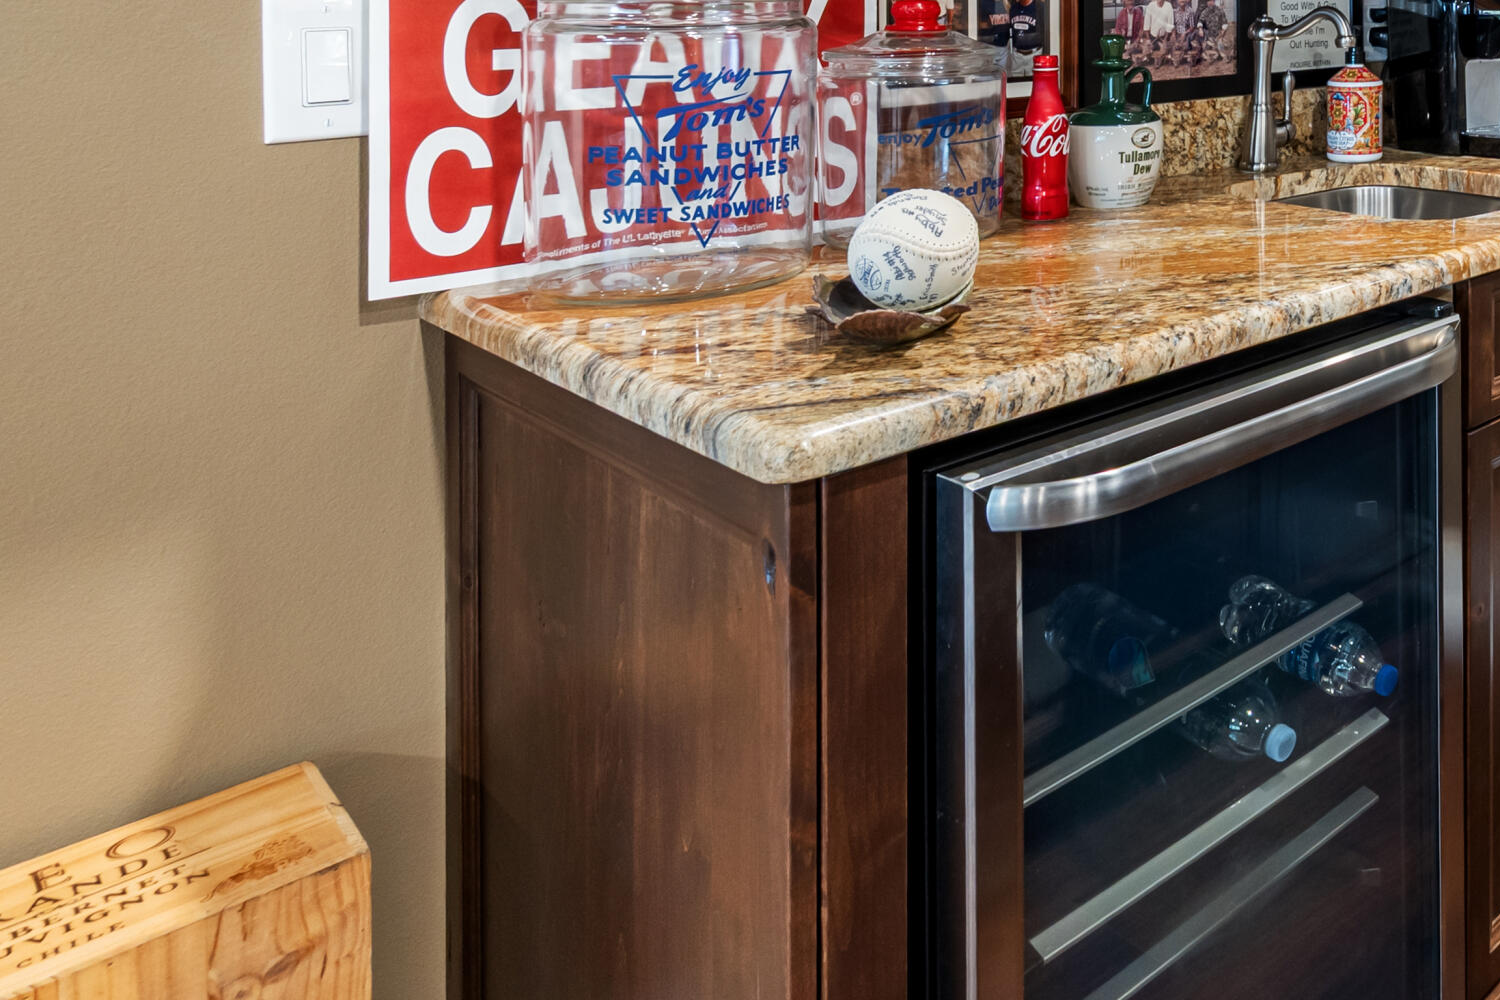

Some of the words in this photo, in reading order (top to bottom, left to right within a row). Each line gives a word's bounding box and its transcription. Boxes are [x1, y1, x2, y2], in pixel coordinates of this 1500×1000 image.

[1280, 1, 1298, 11] Good
[1300, 1, 1315, 10] With
[1281, 14, 1289, 24] To
[1289, 39, 1302, 48] Out
[1304, 38, 1328, 49] Hunting
[1315, 26, 1325, 34] I'm
[672, 64, 751, 96] Enjoy
[656, 91, 766, 142] Tom's
[878, 133, 922, 147] enjoy
[917, 104, 993, 148] Tom's
[588, 144, 707, 164] PEANUT
[717, 134, 800, 159] BUTTER
[606, 158, 788, 187] SANDWICHES
[1133, 164, 1152, 175] Dew
[686, 183, 730, 201] and
[602, 208, 672, 224] SWEET
[680, 194, 790, 221] SANDWICHES
[591, 240, 601, 250] of
[603, 237, 620, 248] The
[637, 230, 681, 244] Lafayette
[0, 845, 182, 923] ANDE
[16, 922, 125, 968] CHILE
